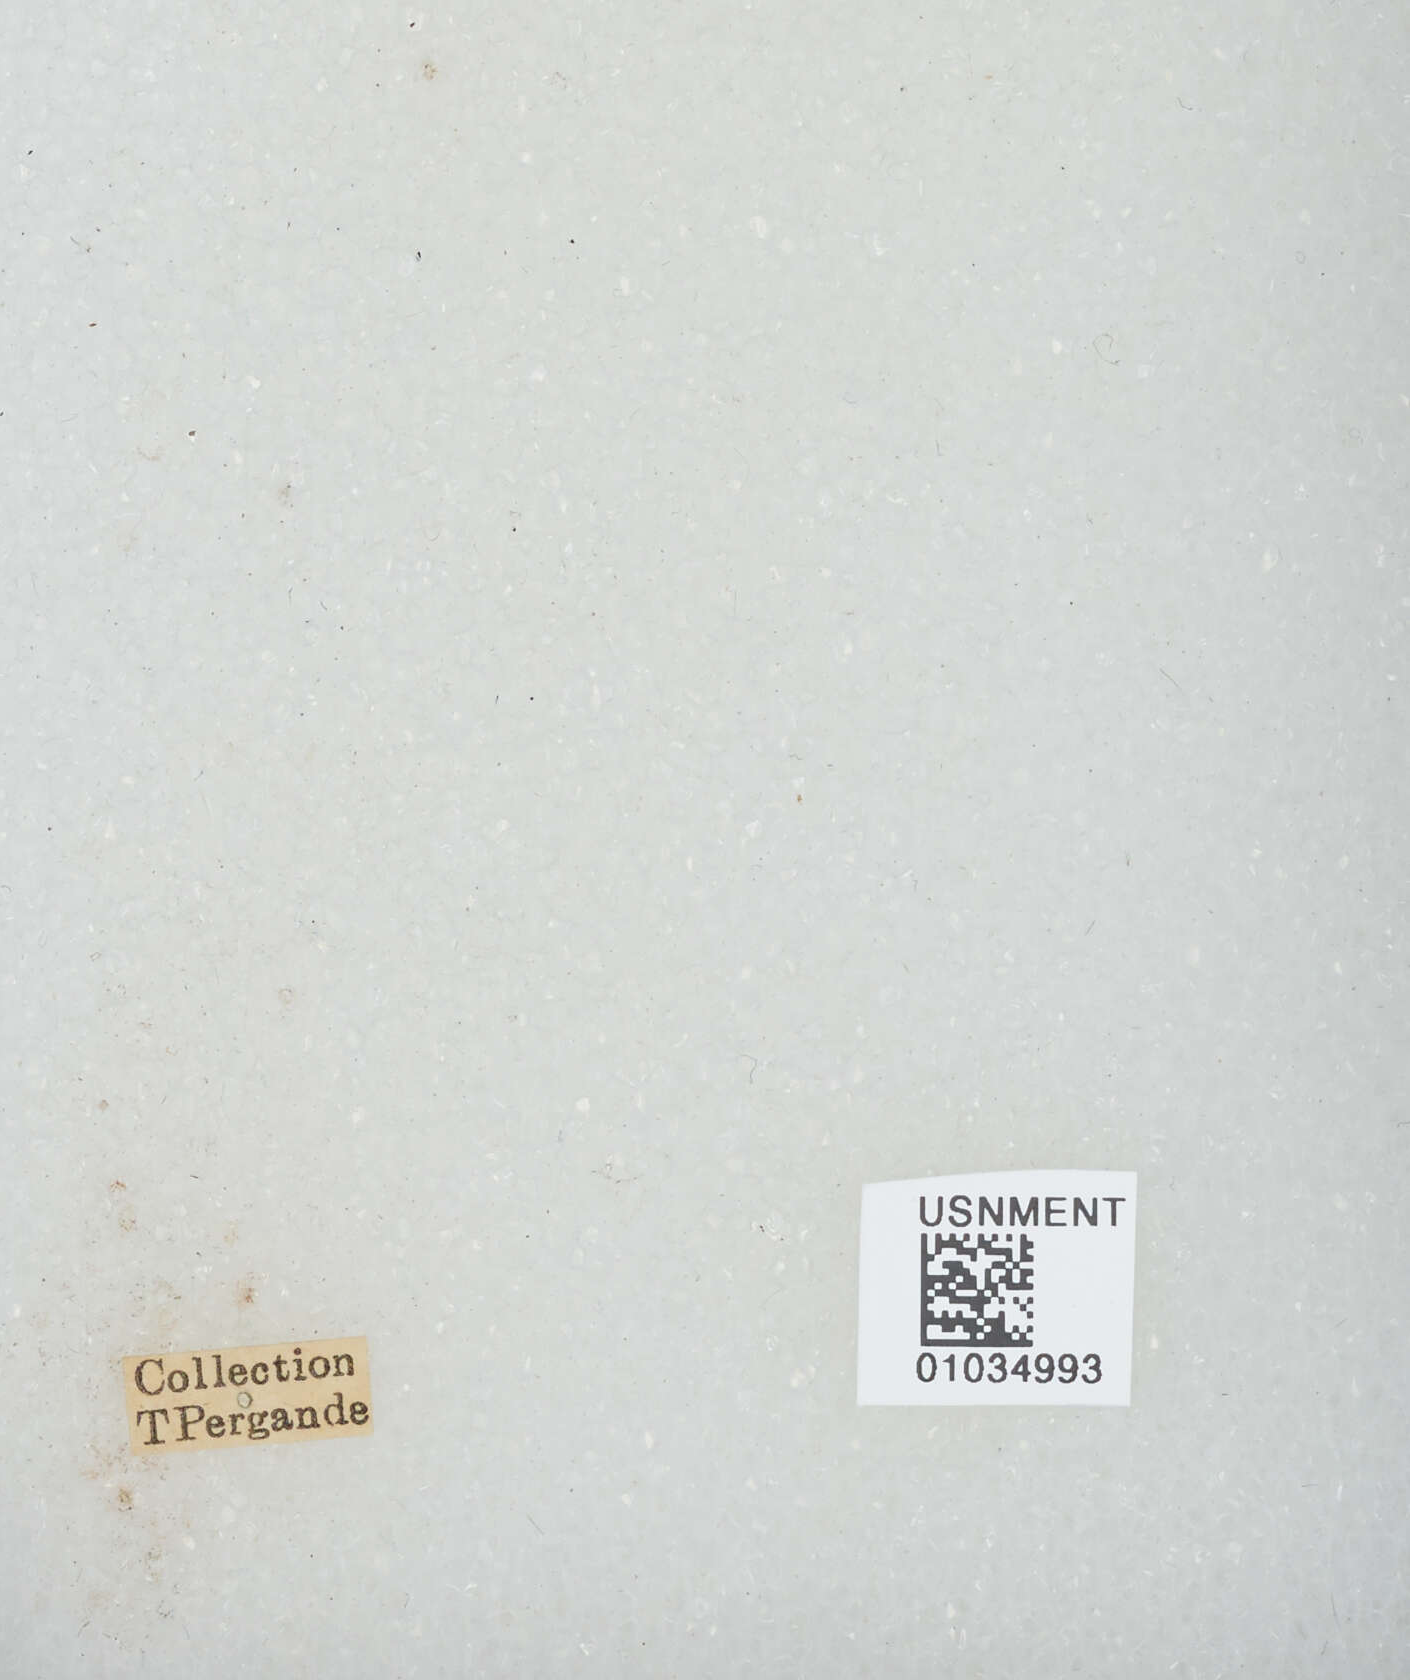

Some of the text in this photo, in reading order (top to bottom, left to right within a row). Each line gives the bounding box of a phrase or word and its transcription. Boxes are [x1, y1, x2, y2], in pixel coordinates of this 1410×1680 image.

[919, 1195, 1126, 1227] USNMENT
[135, 1347, 355, 1396] Collection
[916, 1352, 1102, 1384] 01034993
